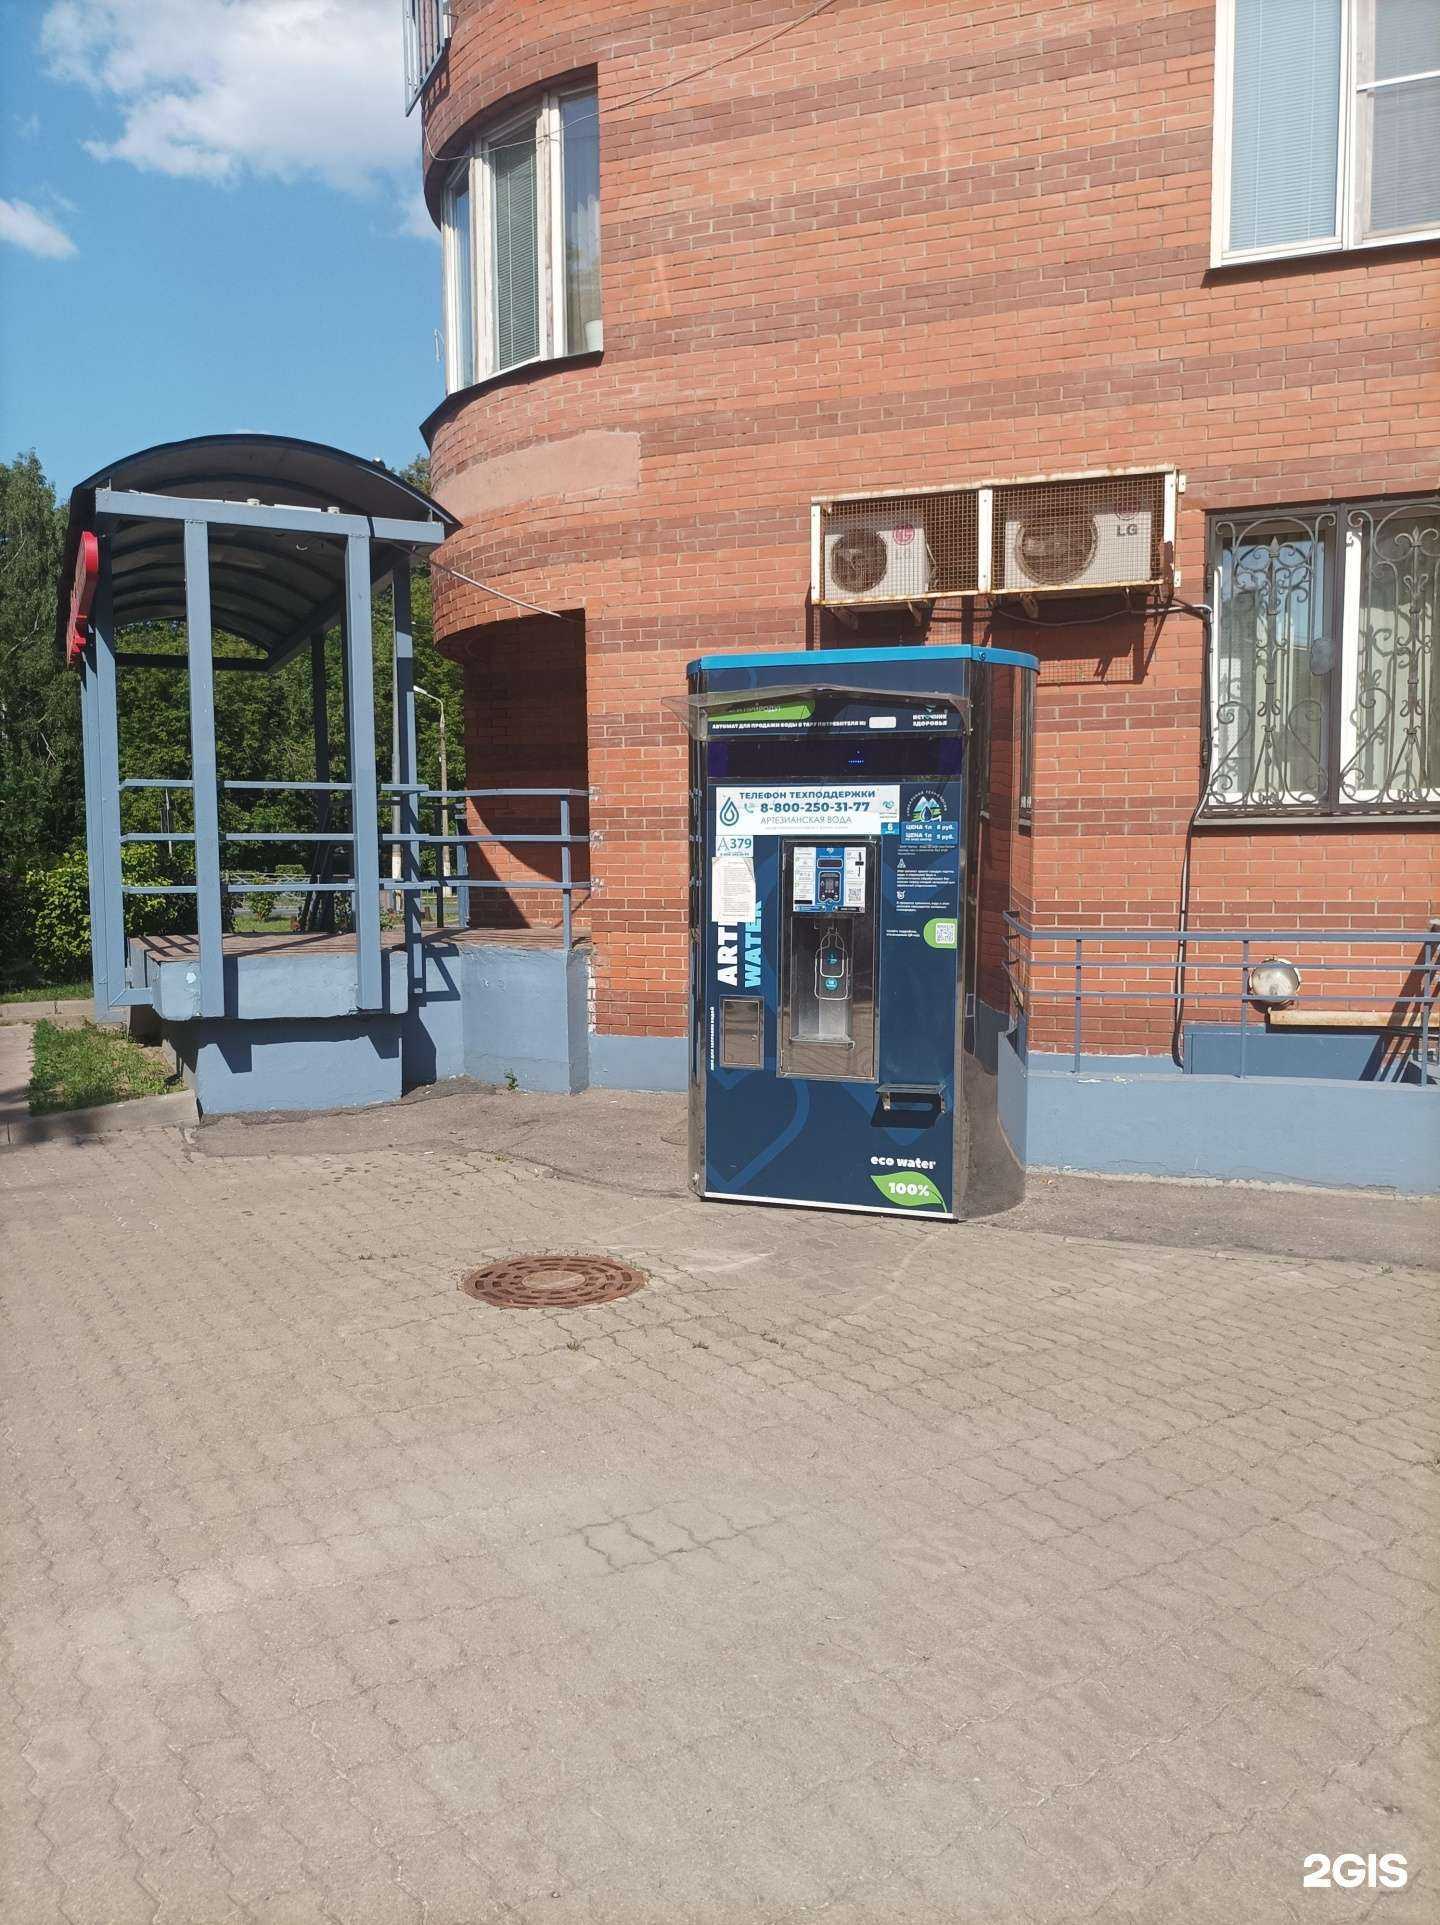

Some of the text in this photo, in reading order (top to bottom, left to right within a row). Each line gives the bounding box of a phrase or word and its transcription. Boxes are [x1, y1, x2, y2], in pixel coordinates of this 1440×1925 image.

[1117, 524, 1138, 537] LG
[739, 790, 876, 800] ТЕЛЕФОН ТЕХПОДДЕРЖКИ
[760, 802, 870, 813] 8-800-250-31-77
[760, 815, 852, 825] АРТЕЗИАНСКАЯ ВОДА
[870, 1156, 937, 1169] eco water
[888, 1182, 930, 1197] 100%
